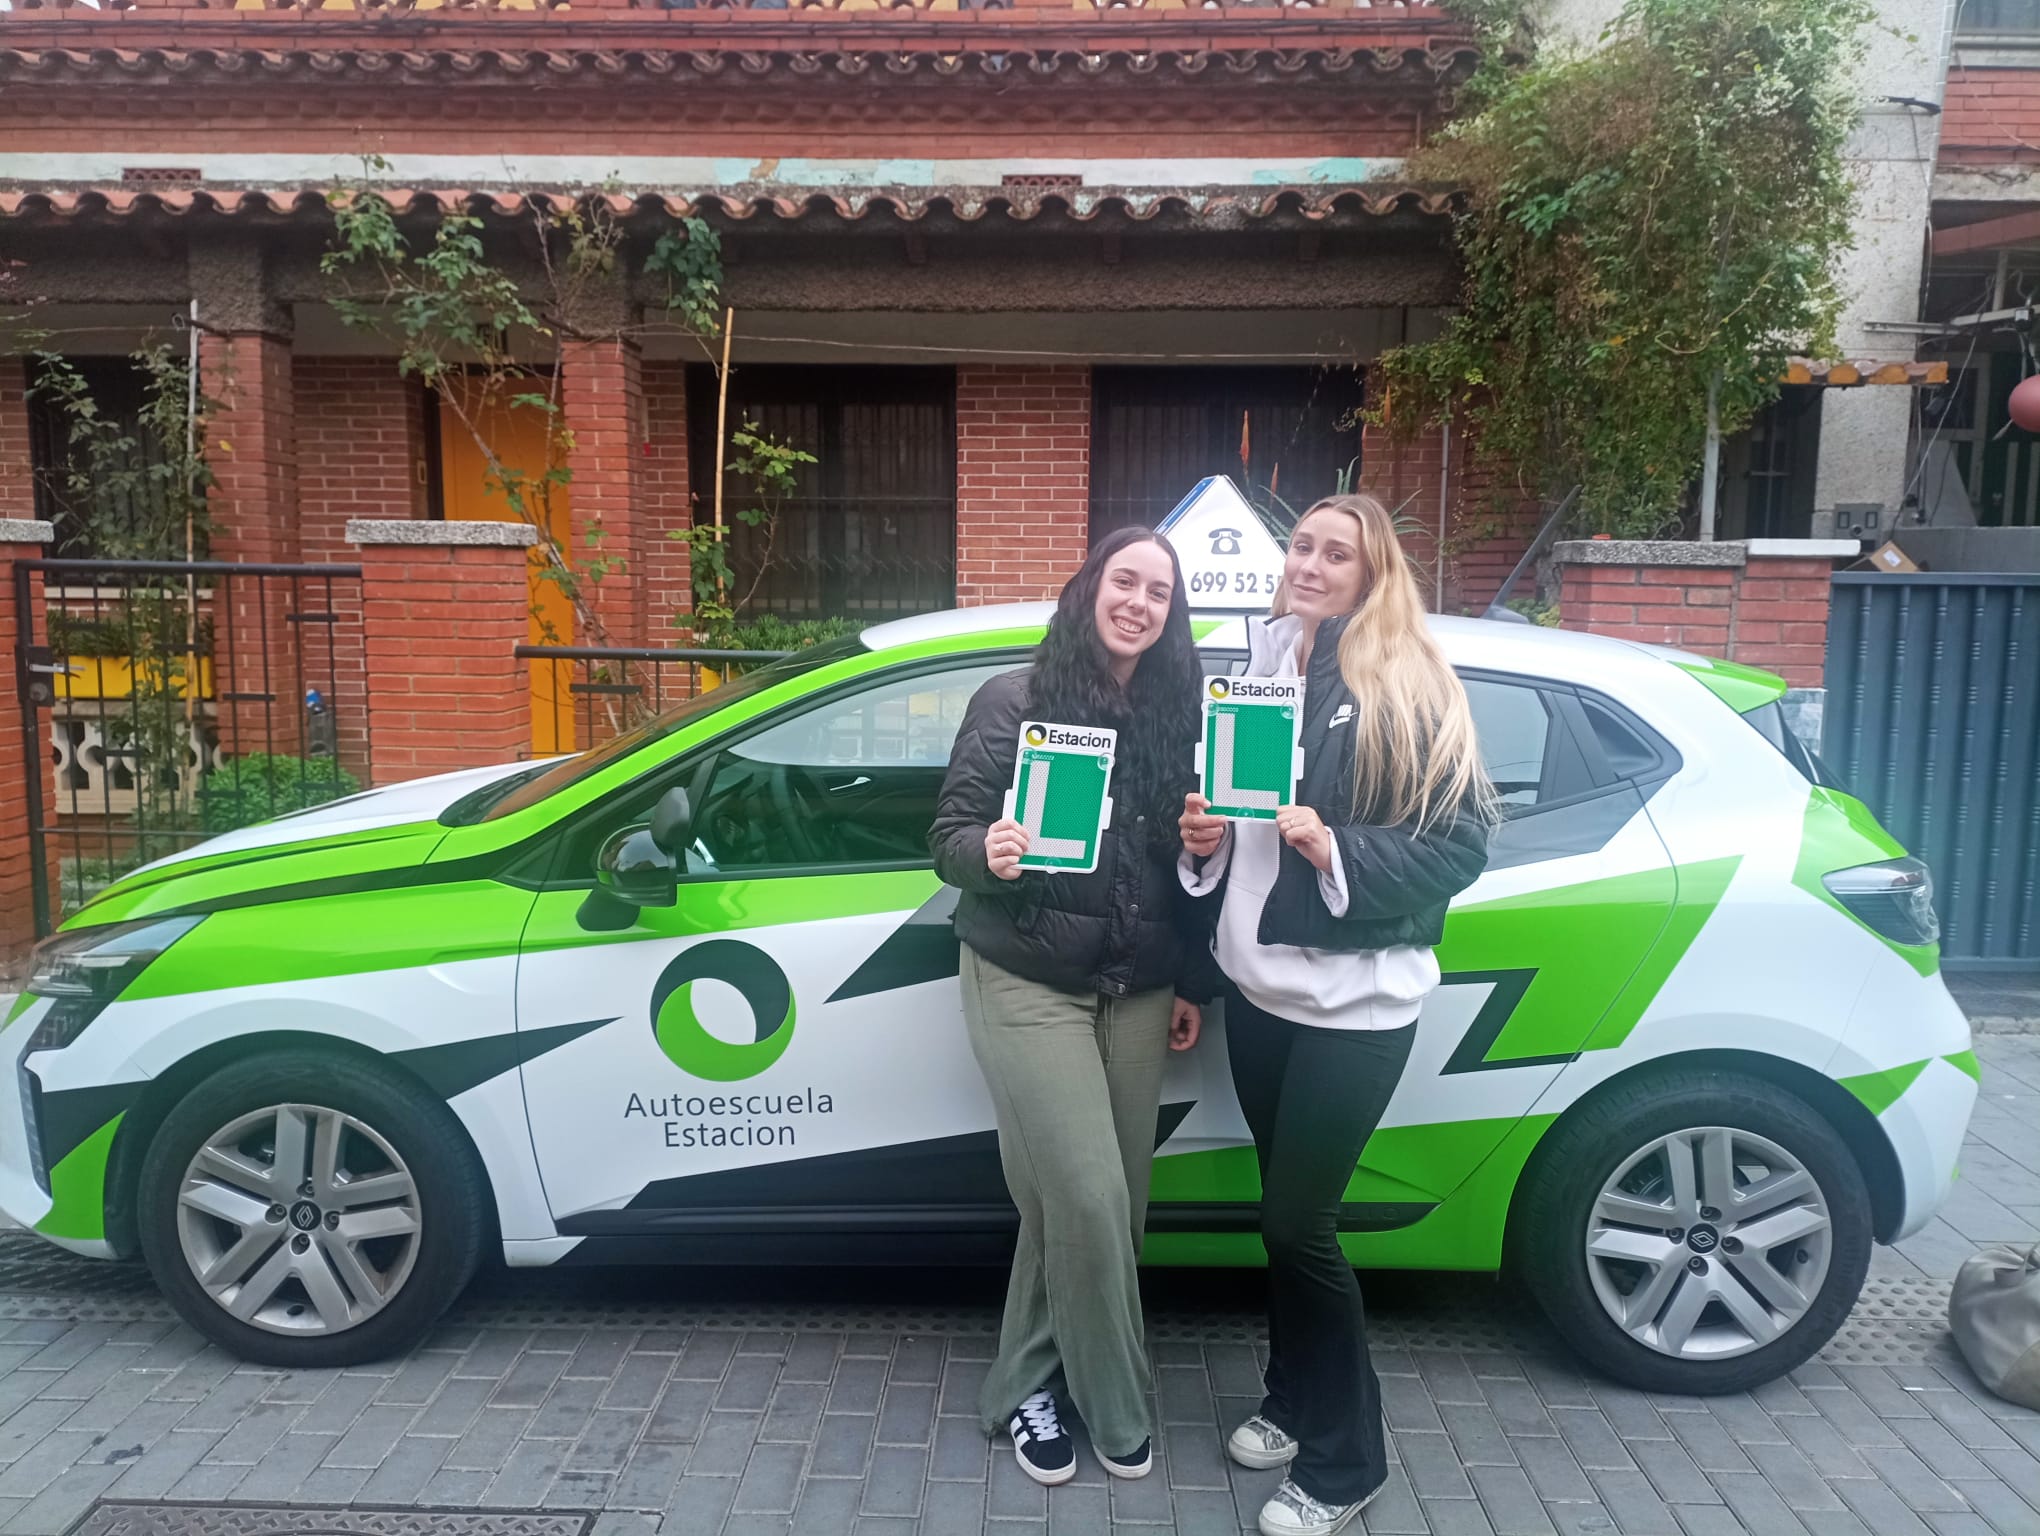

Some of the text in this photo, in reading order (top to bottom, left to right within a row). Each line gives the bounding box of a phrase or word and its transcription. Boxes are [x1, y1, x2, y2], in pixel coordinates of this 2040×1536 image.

[1190, 571, 1284, 594] 699 52 5
[1231, 681, 1296, 698] Estacion
[1048, 729, 1112, 750] Estacion
[1212, 711, 1280, 811] L
[1022, 760, 1086, 860] L
[624, 1086, 834, 1119] Autoescuela
[664, 1119, 796, 1148] Estacion
